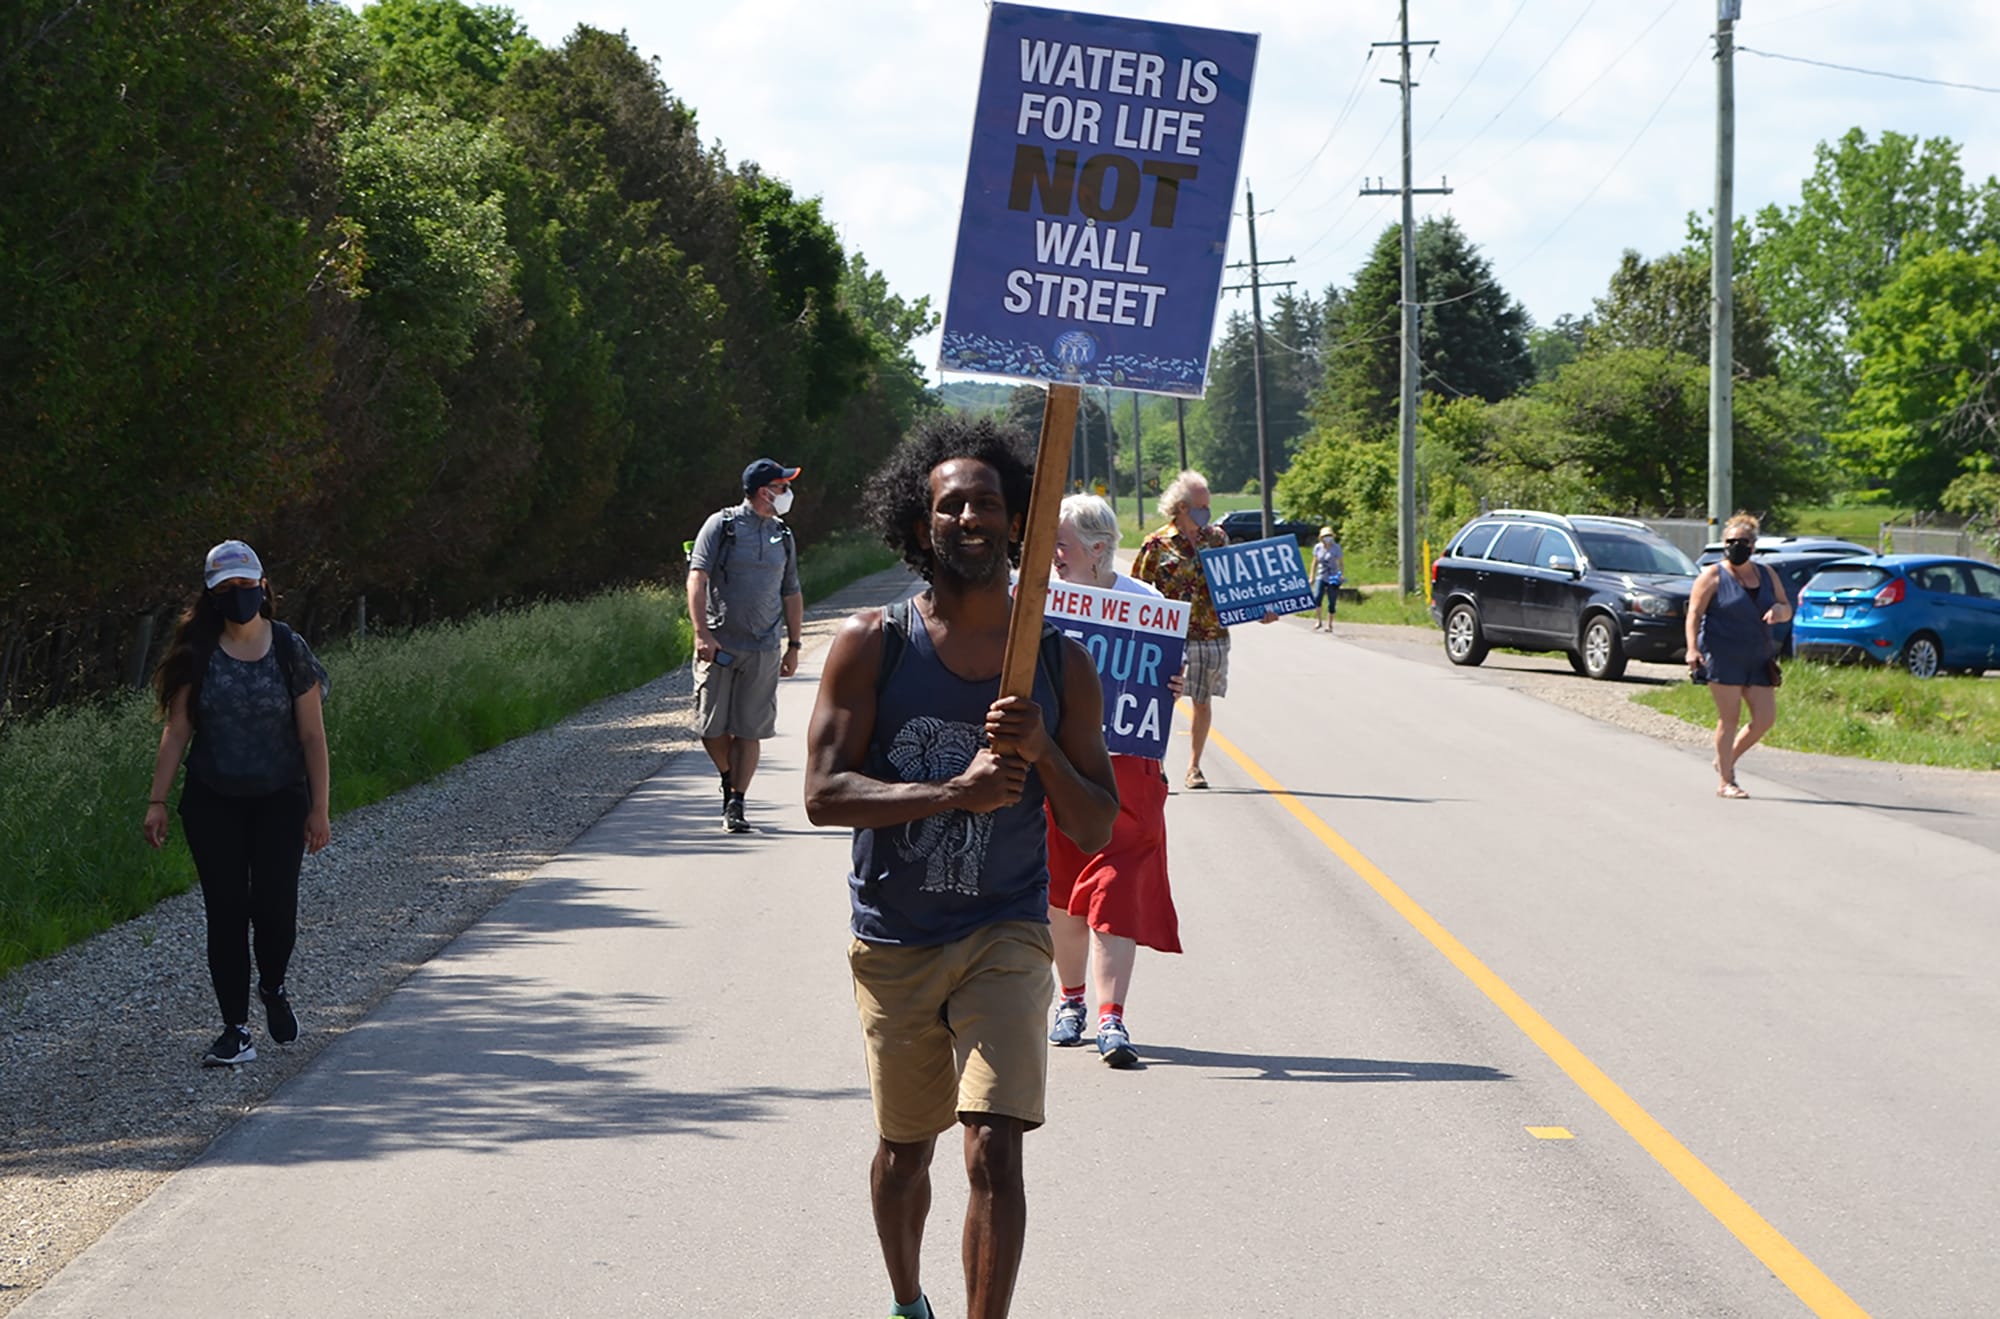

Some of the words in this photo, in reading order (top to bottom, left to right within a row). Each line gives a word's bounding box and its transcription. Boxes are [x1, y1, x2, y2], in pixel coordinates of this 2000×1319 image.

[1020, 38, 1165, 98] WATER
[1177, 59, 1219, 104] IS
[1017, 93, 1102, 144] FOR
[1114, 105, 1204, 156] LIFE
[1008, 144, 1198, 229] NOT
[1036, 220, 1149, 275] WALL
[1003, 269, 1166, 328] STREET
[1206, 543, 1299, 586] WATER
[1215, 591, 1228, 604] Is
[1228, 586, 1255, 602] Not
[1256, 581, 1276, 596] for
[1278, 575, 1306, 592] Sale
[1101, 597, 1129, 623] WE
[1138, 605, 1180, 631] CAN
